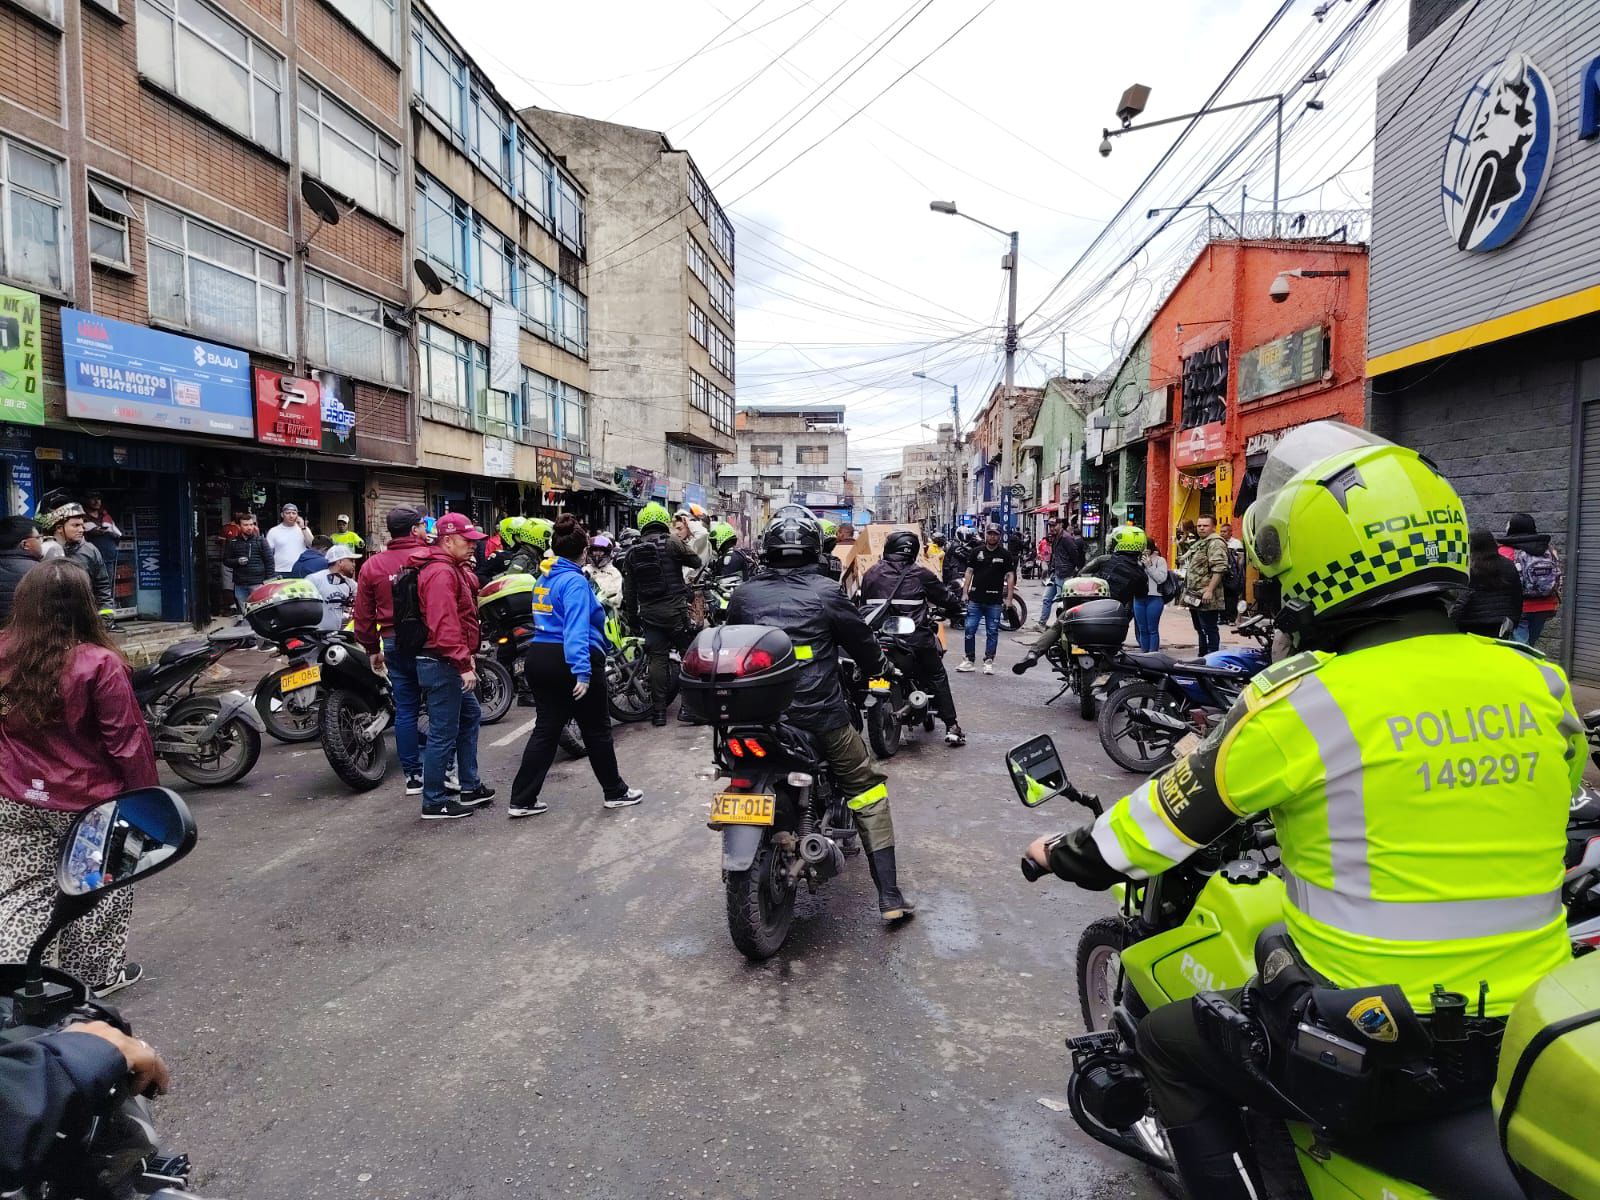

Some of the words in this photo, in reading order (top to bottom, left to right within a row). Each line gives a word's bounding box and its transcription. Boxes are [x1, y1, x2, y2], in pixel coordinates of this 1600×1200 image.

[207, 353, 239, 369] BAJAJ
[80, 362, 122, 381] NUBIA
[124, 370, 167, 389] MOTOS
[326, 408, 355, 424] PROFE
[1363, 504, 1464, 540] POLICÍA
[1386, 702, 1543, 752] POLICIA
[1416, 751, 1540, 792] 149297
[1186, 780, 1203, 796] Y
